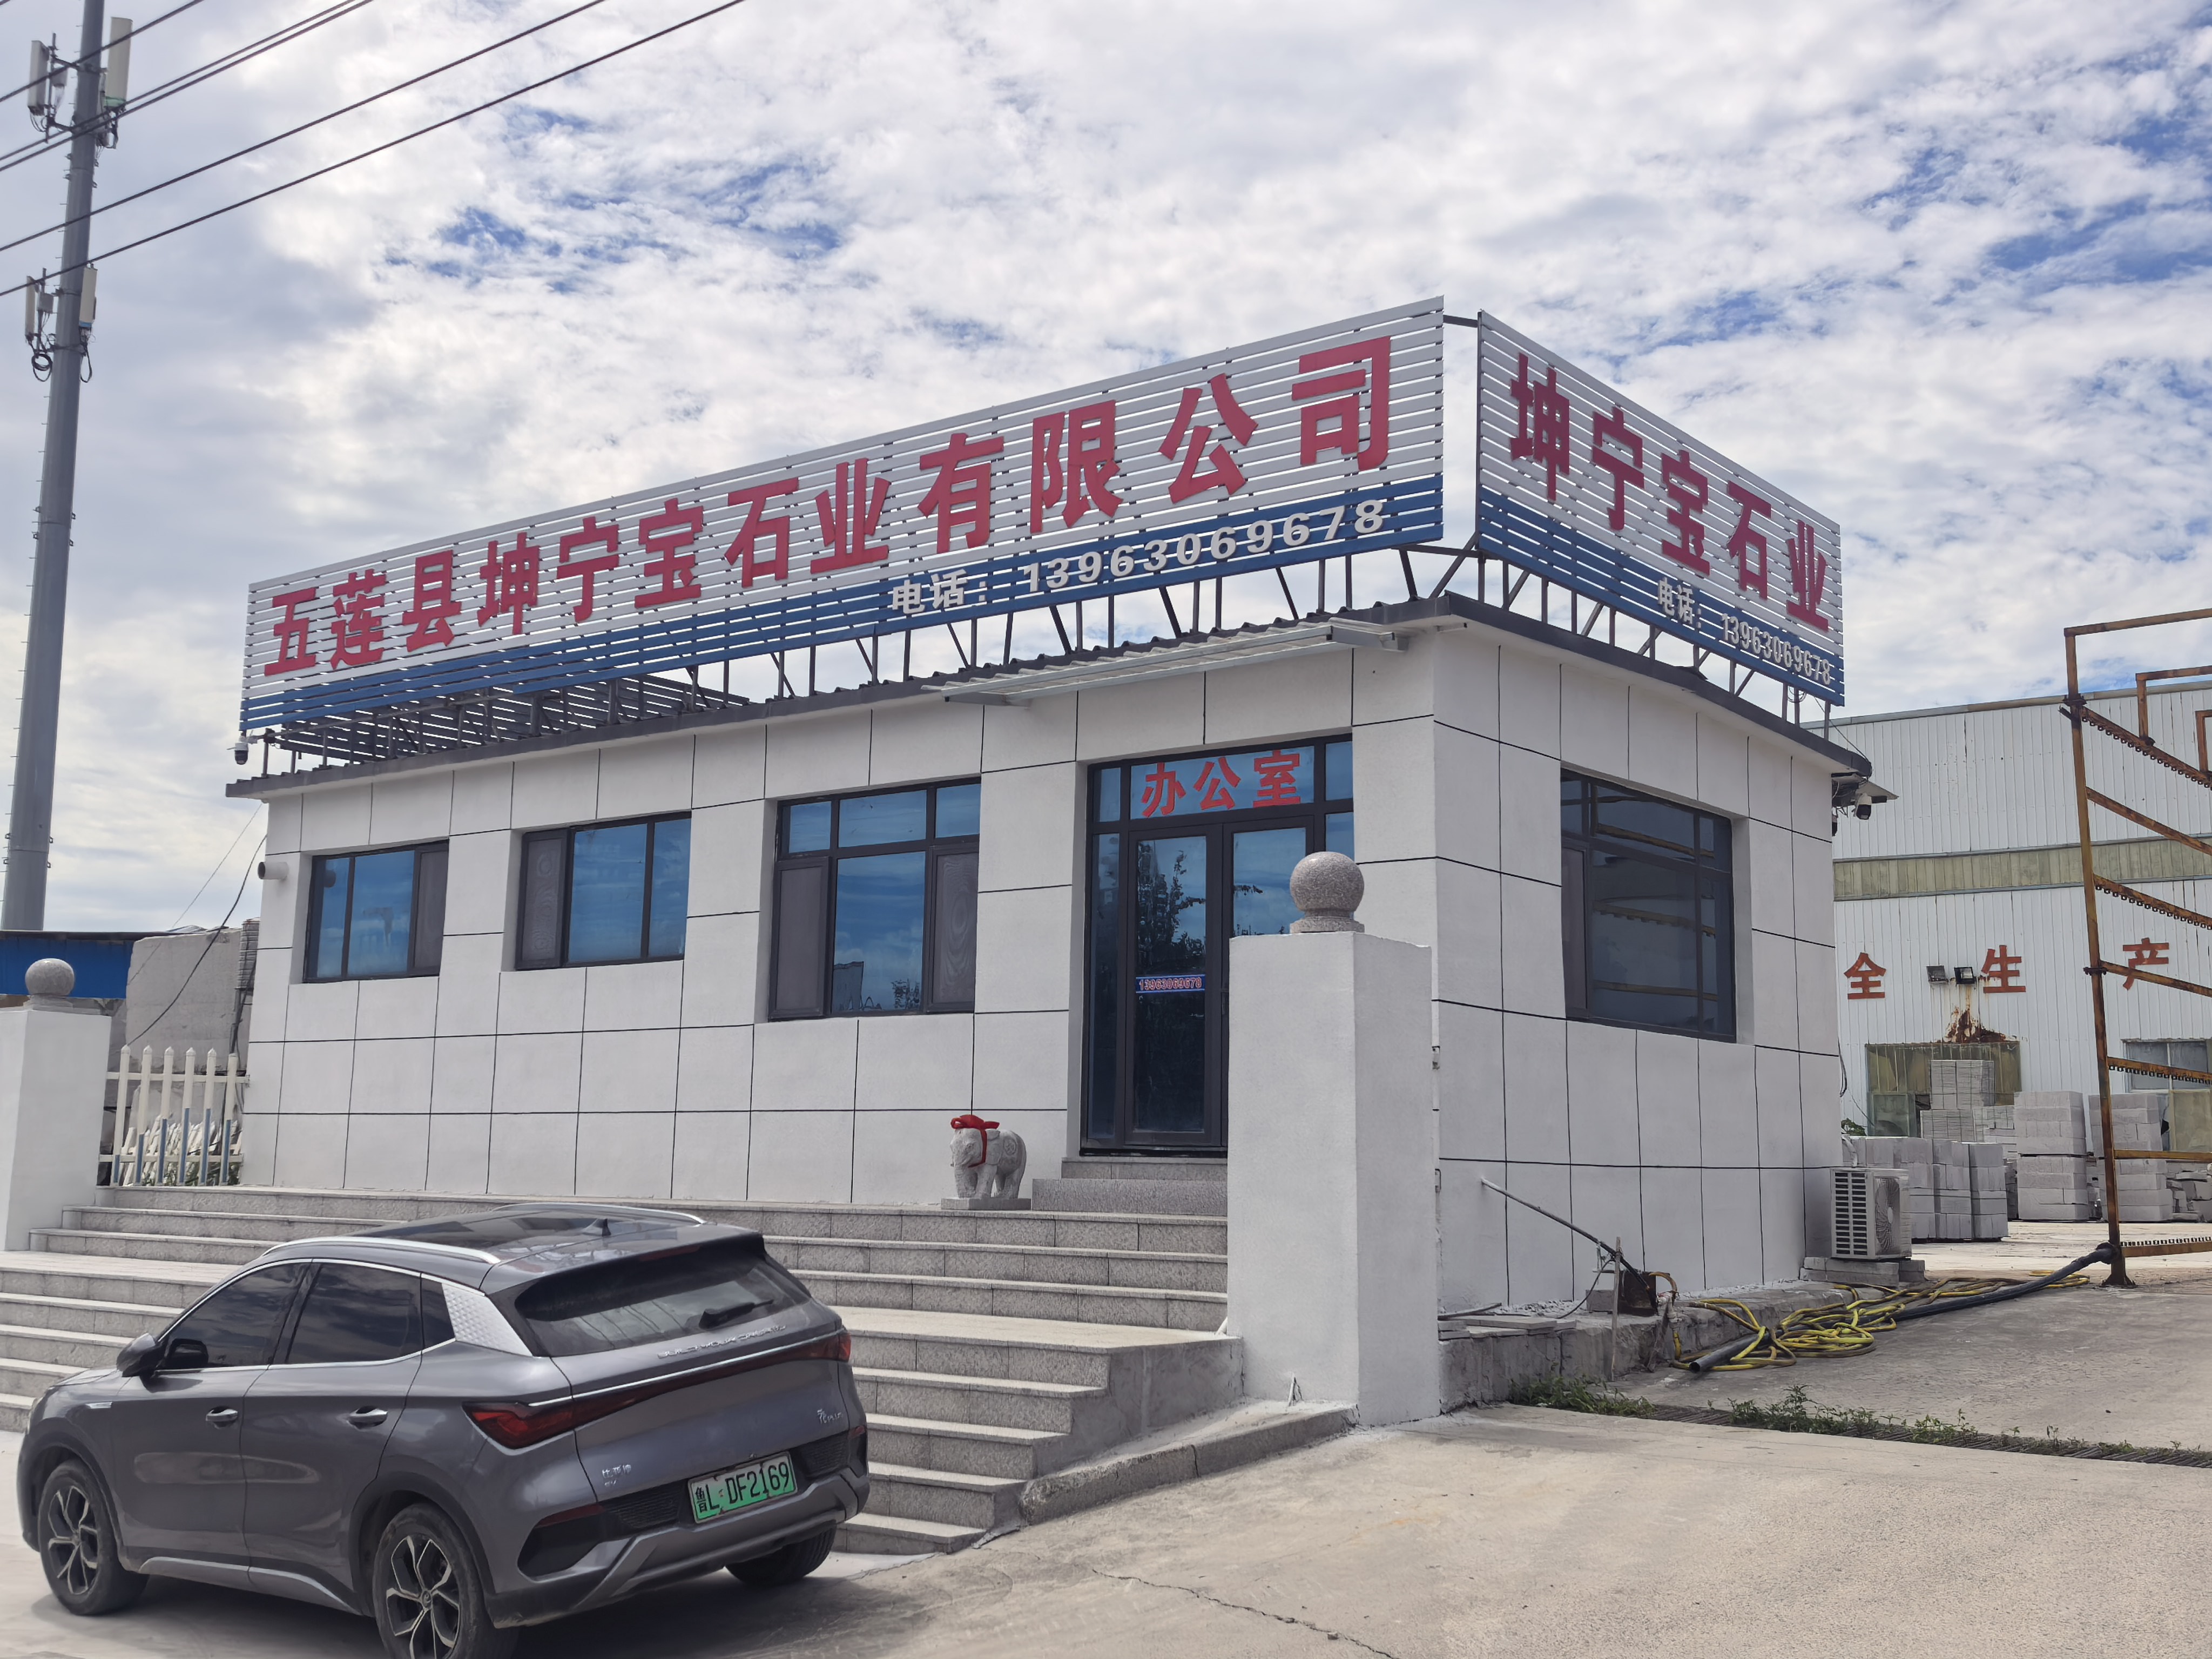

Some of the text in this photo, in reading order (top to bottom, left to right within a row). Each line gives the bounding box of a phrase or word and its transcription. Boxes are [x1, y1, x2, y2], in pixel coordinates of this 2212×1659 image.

[264, 336, 1391, 676] 五莲县坤宁宝石业有限公司
[1510, 353, 1829, 632] 坤宁宝石业
[1023, 499, 1384, 592] 13963069678
[1721, 612, 1831, 685] 13963069678
[1141, 750, 1301, 818] 办公室
